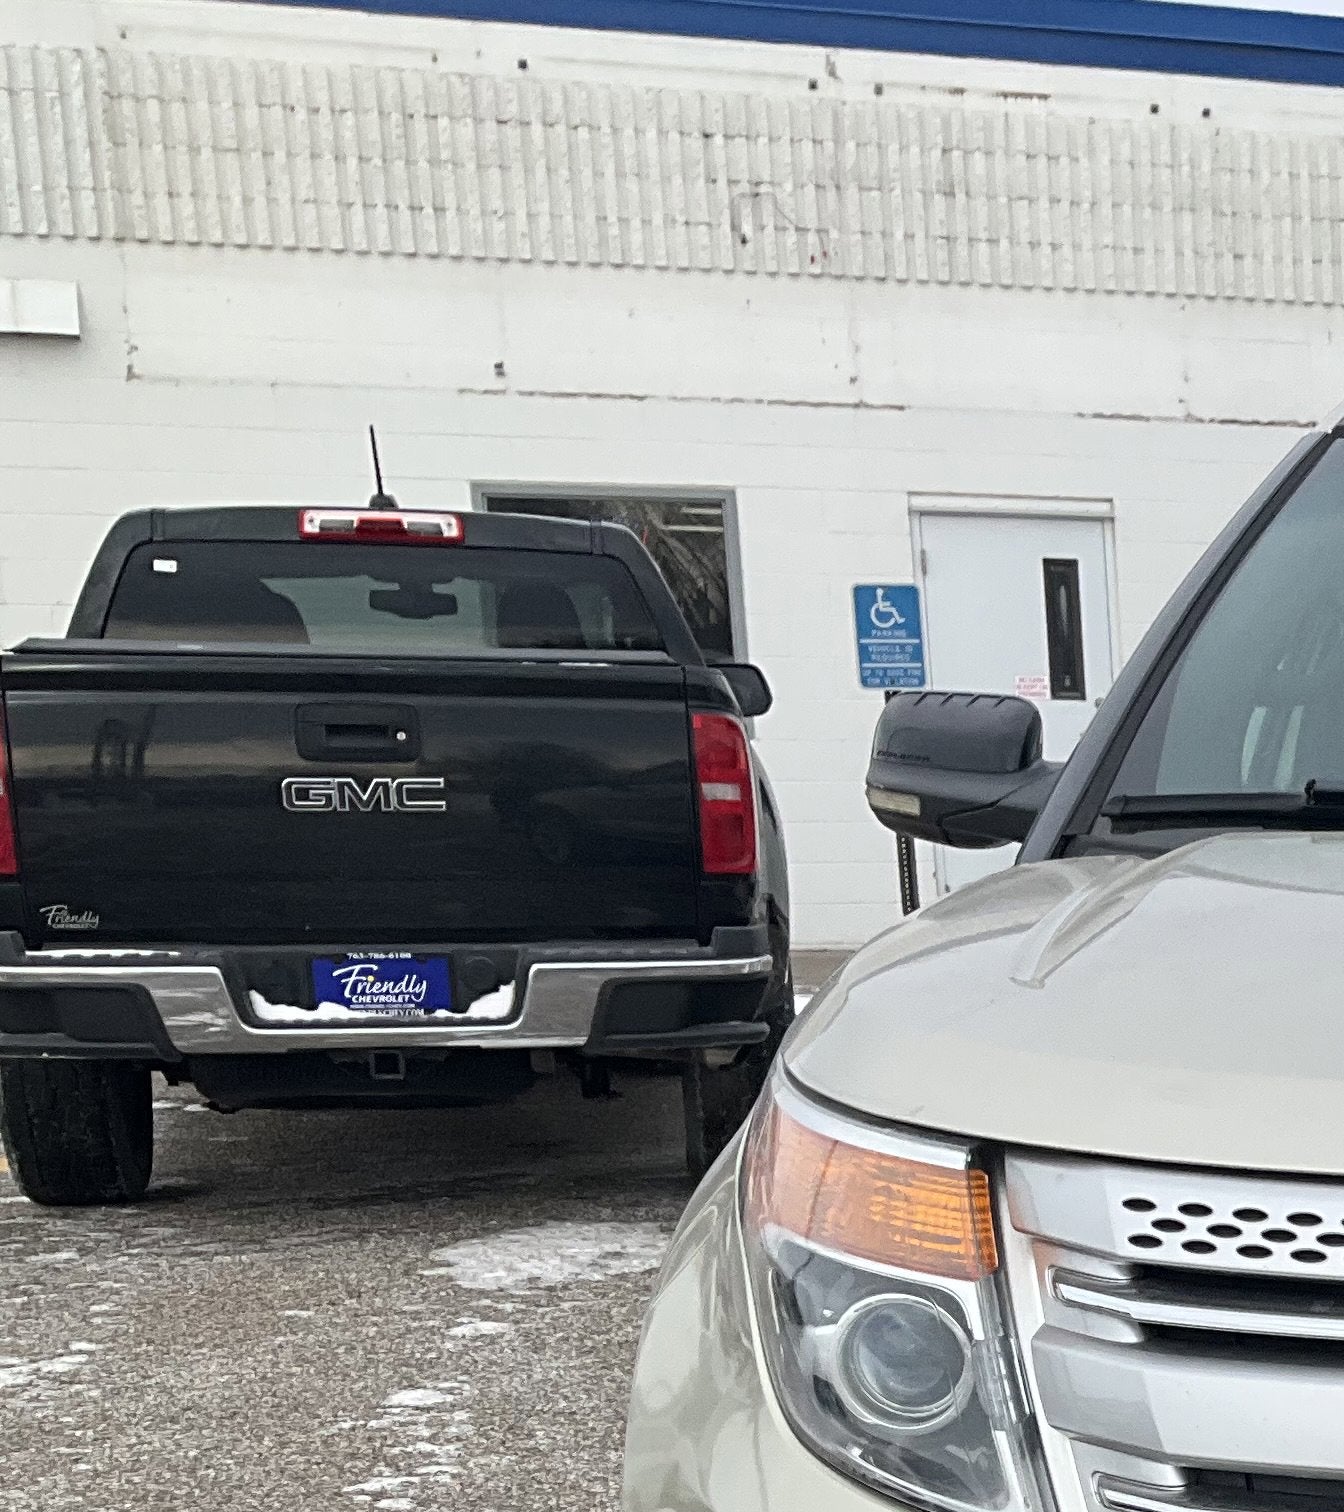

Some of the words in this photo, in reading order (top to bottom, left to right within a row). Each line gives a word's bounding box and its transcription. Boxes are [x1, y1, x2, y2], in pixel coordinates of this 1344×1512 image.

[281, 777, 447, 812] GMC
[39, 904, 100, 929] Friendly
[332, 963, 427, 1003] Friendly
[351, 994, 410, 1004] CHEVROLET
